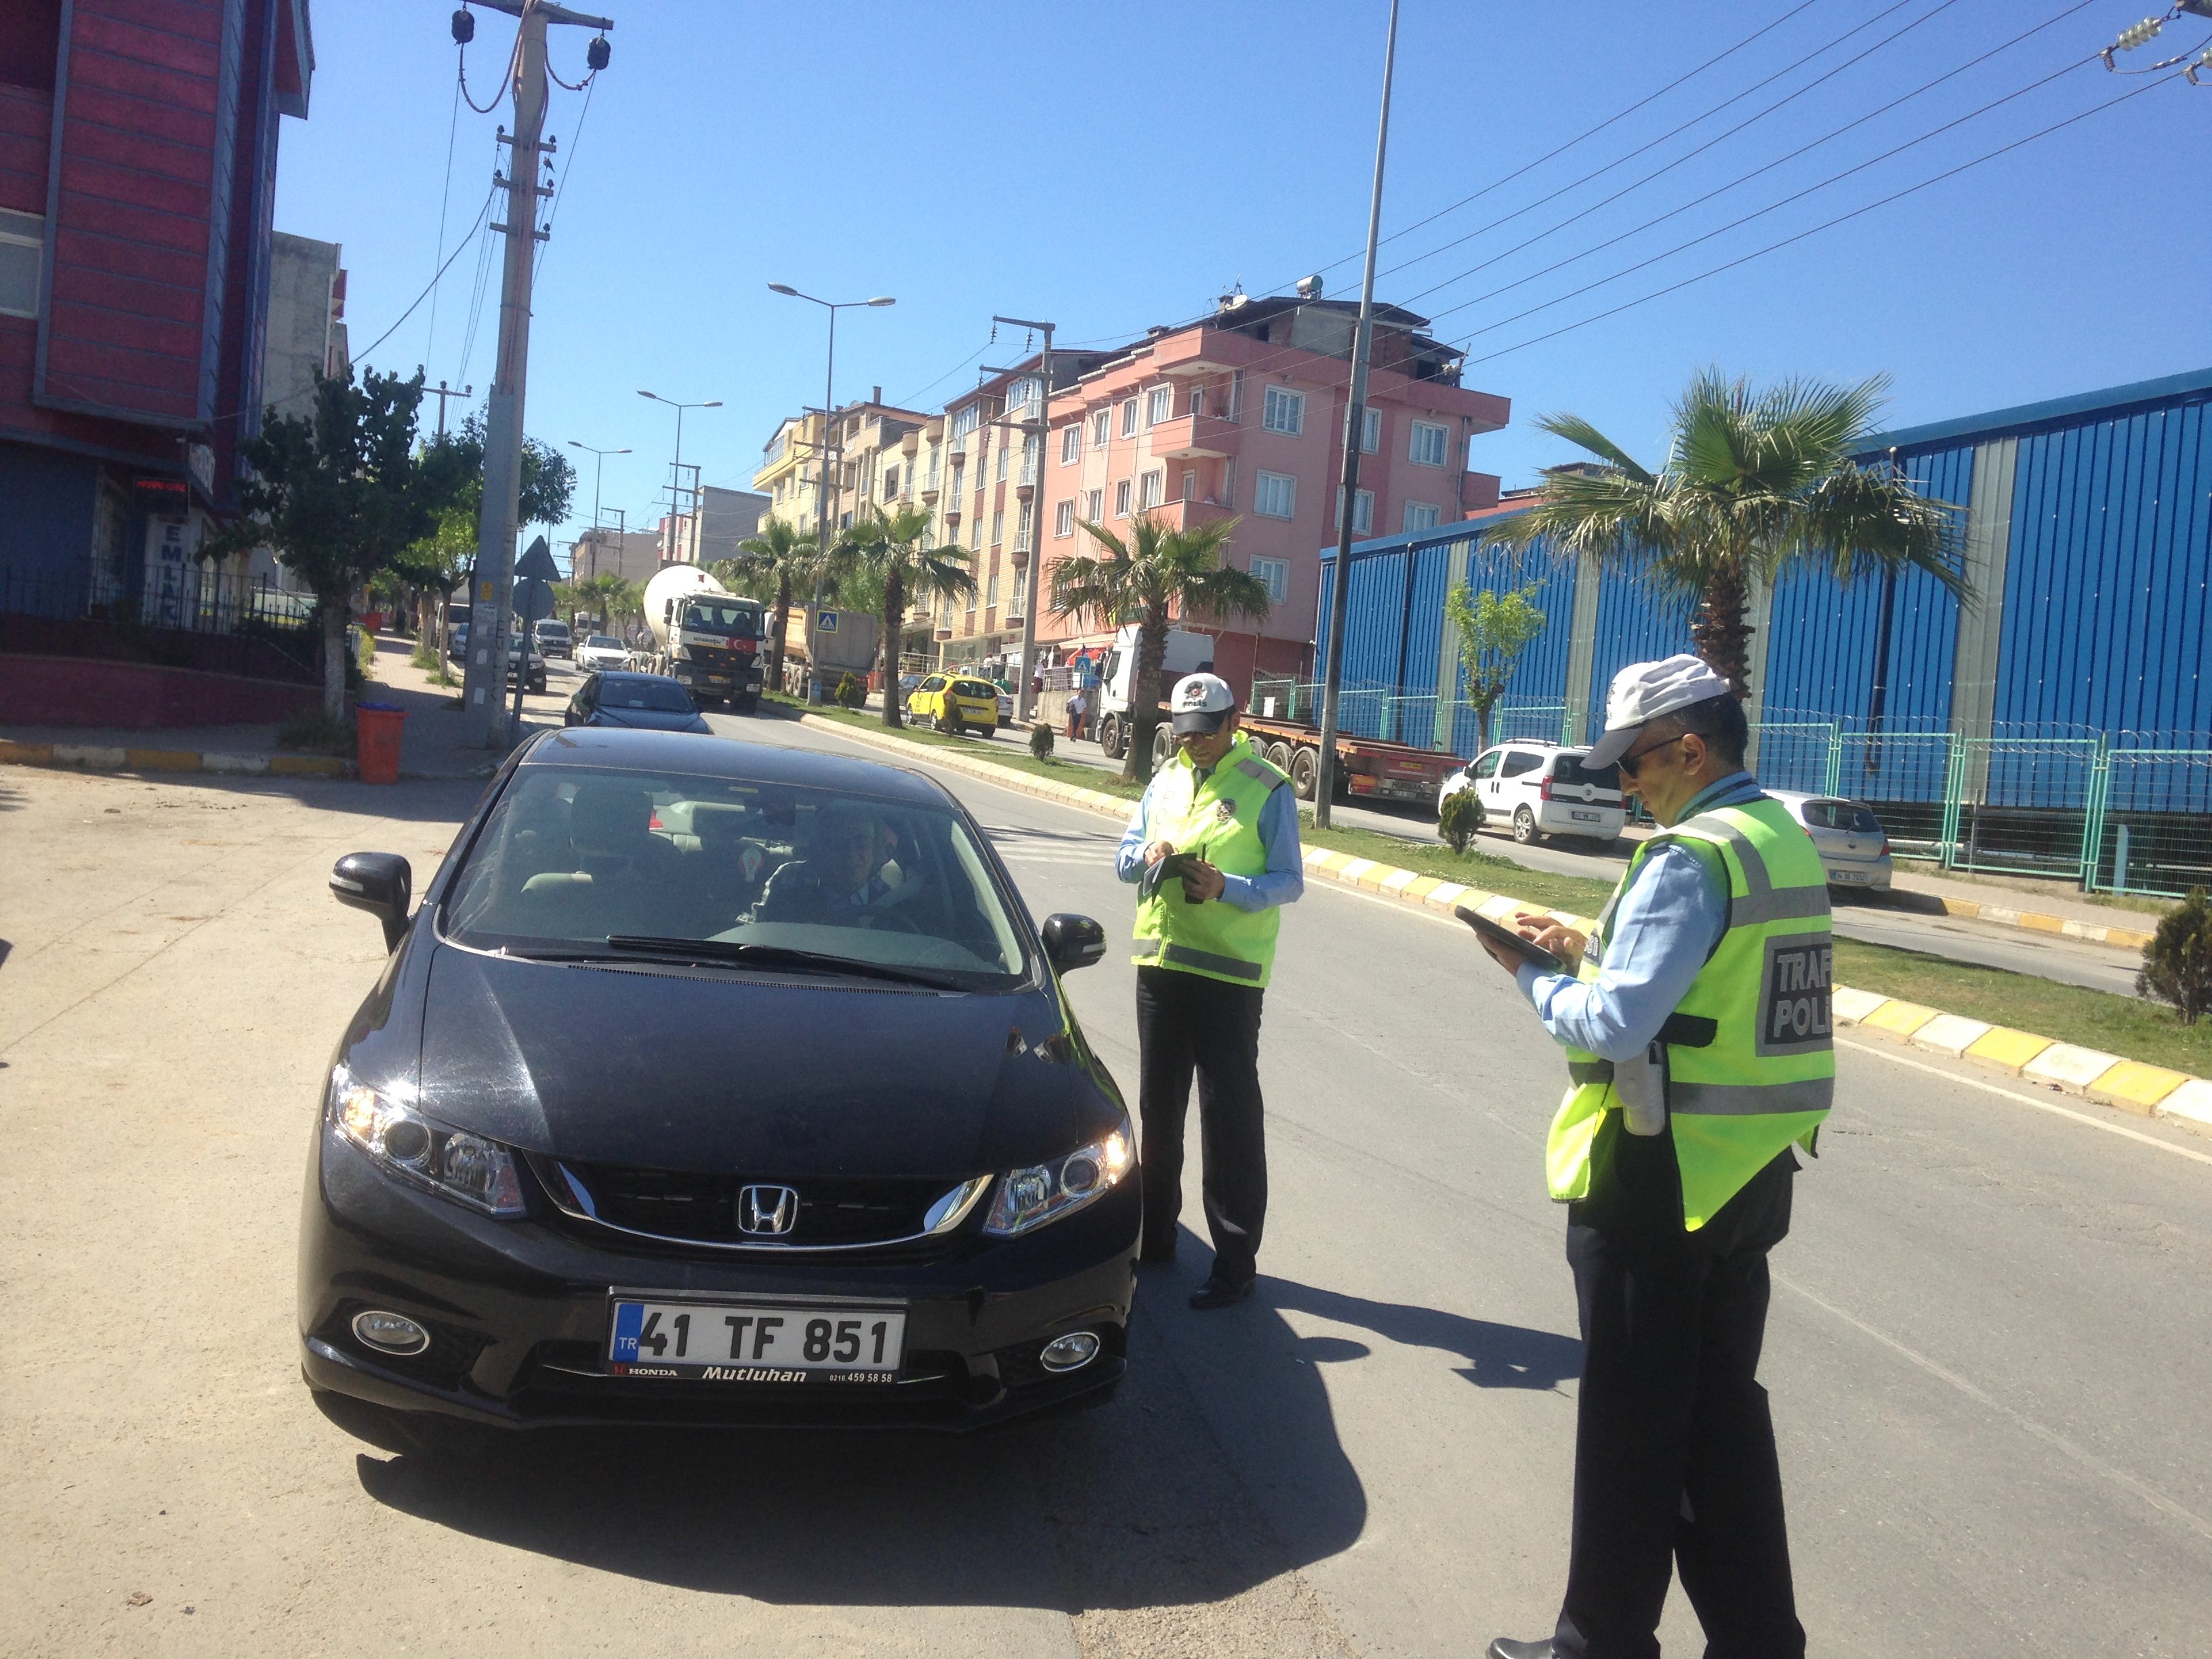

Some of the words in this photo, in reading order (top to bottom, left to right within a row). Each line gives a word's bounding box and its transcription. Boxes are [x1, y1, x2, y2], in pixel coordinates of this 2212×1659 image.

[619, 1337, 638, 1351] TR
[639, 1312, 691, 1357] 41
[724, 1316, 784, 1359] TF
[803, 1319, 887, 1364] 851
[628, 1368, 678, 1376] HONDA
[701, 1366, 806, 1383] Mutluhan
[867, 1373, 878, 1382] 58
[881, 1373, 893, 1383] 58
